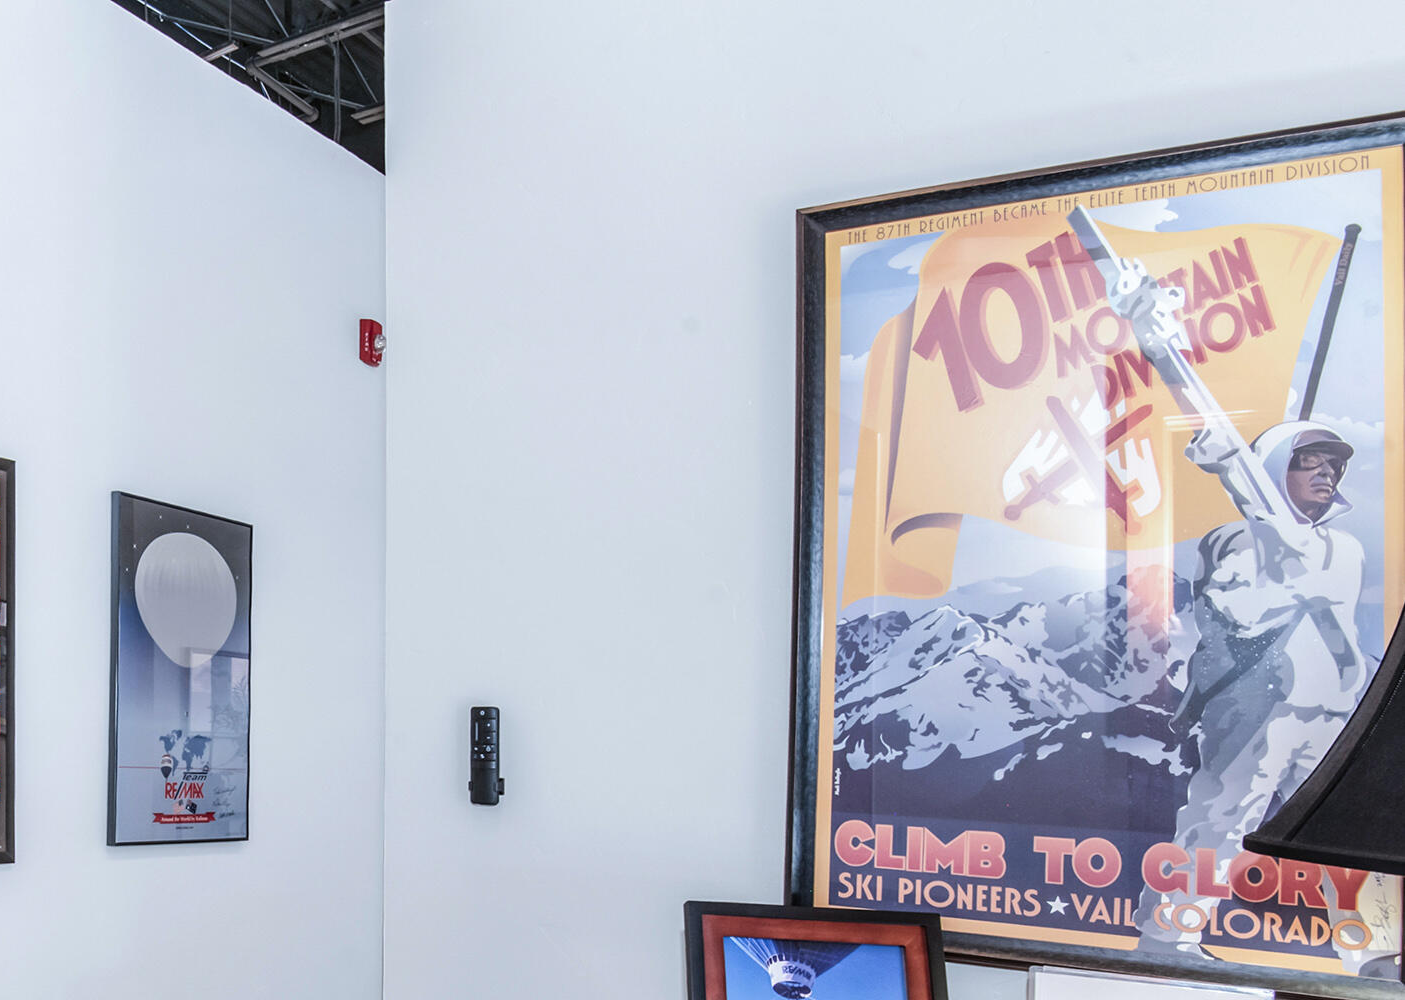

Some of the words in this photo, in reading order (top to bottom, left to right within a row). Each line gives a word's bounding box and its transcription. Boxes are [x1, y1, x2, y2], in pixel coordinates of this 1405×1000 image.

[847, 228, 867, 245] THE
[876, 223, 911, 241] 87TH
[919, 210, 985, 233] REGIMENT
[994, 201, 1047, 223] BECAME
[1057, 197, 1081, 213] THE
[1090, 191, 1125, 209] ELITE
[1135, 183, 1176, 202] TENTH
[1186, 168, 1275, 195] MOUNTAIN
[1286, 155, 1371, 181] DIVISION
[912, 230, 1108, 413] 10TH
[164, 781, 204, 800] RE/MAX
[182, 772, 208, 781] Team
[834, 819, 1007, 879] CLIMB
[1033, 835, 1122, 888] TO
[1141, 842, 1370, 912] GLORY
[837, 871, 883, 901] SKI
[898, 877, 1042, 917] PIONEERS
[1070, 892, 1136, 927] VAIL
[1153, 902, 1373, 951] COLORADO
